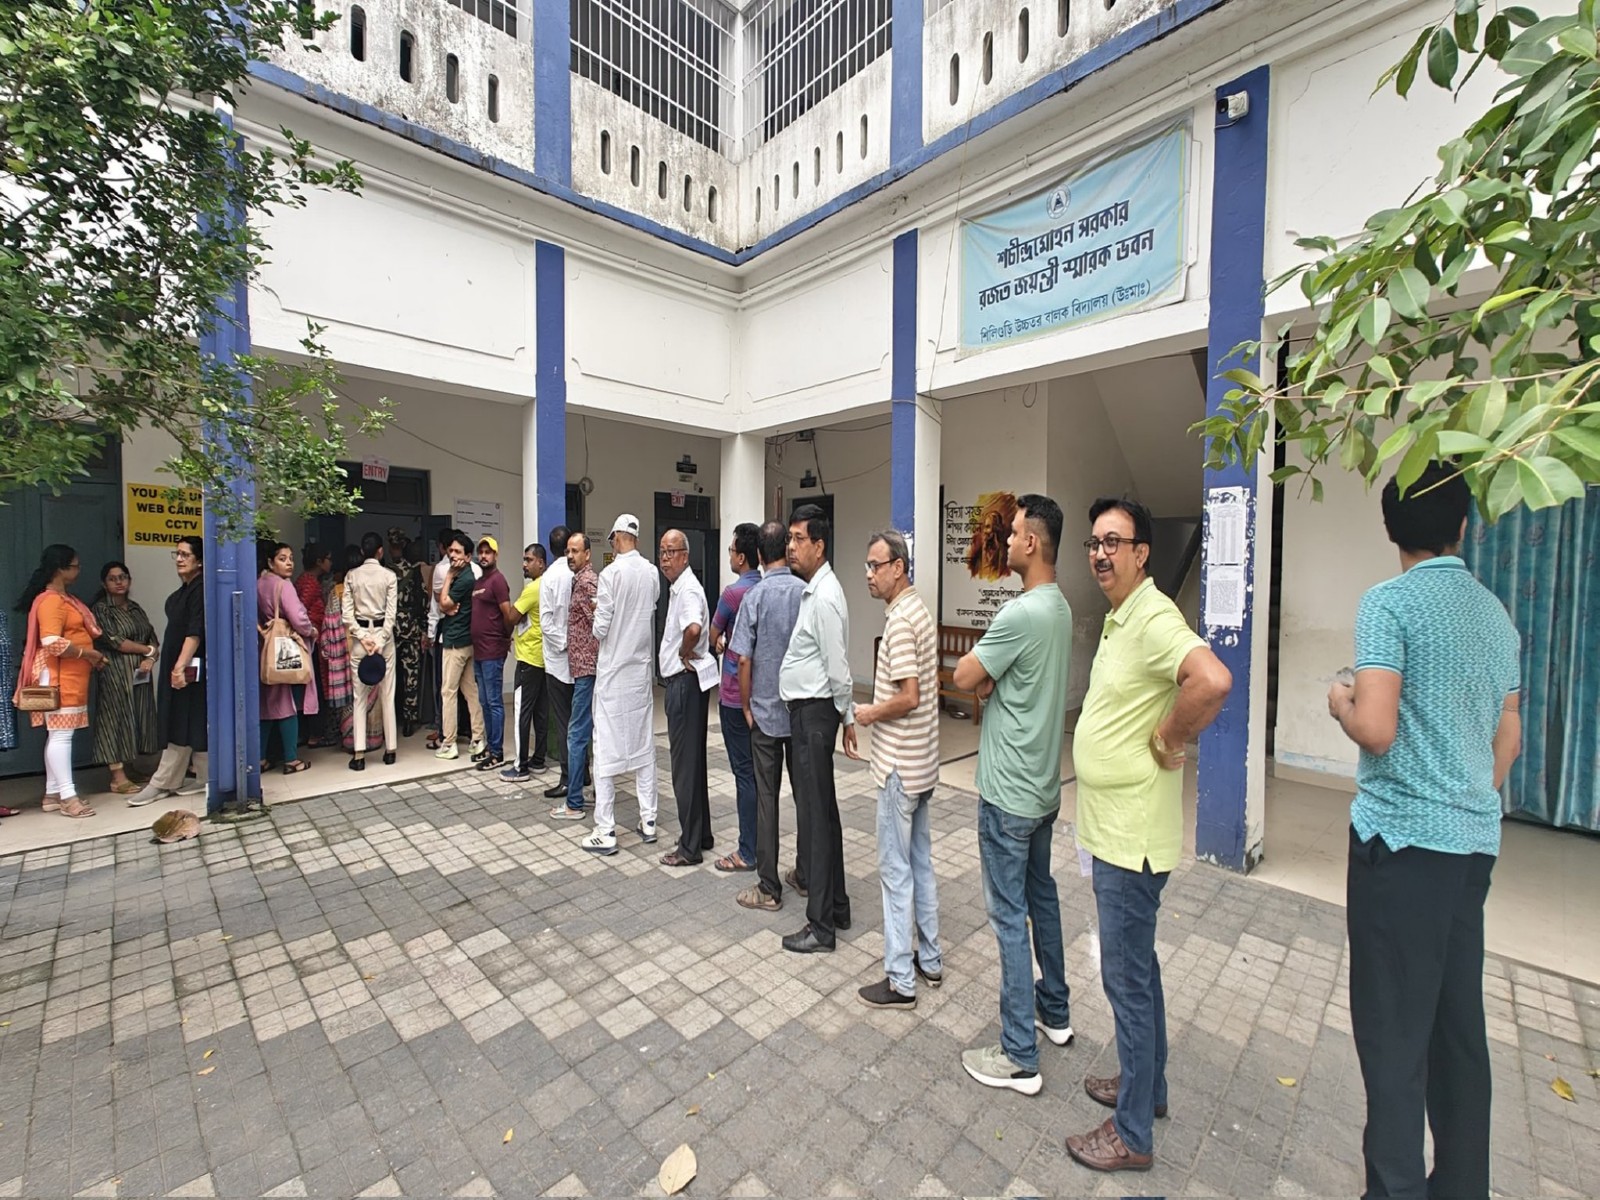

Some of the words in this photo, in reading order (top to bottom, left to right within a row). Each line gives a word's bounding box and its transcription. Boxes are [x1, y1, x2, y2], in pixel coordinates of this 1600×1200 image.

[997, 222, 1074, 269] শচীন্দ্রমোহন
[1078, 200, 1129, 239] সরকার
[978, 281, 1011, 310] রজত
[1014, 256, 1060, 297] জয়ন্তী
[1062, 243, 1113, 280] স্মারক
[1116, 228, 1155, 261] ভবন
[980, 320, 1013, 343] শিলিগুড়ি
[1014, 314, 1042, 335] উচ্চতর
[1045, 306, 1069, 324] বালক
[1071, 293, 1109, 317] বিদ্যালয়
[364, 464, 387, 479] ENTRY
[131, 487, 158, 499] YOU
[137, 502, 164, 514] WEB
[165, 519, 198, 530] CCTV
[135, 532, 184, 543] SURVIE
